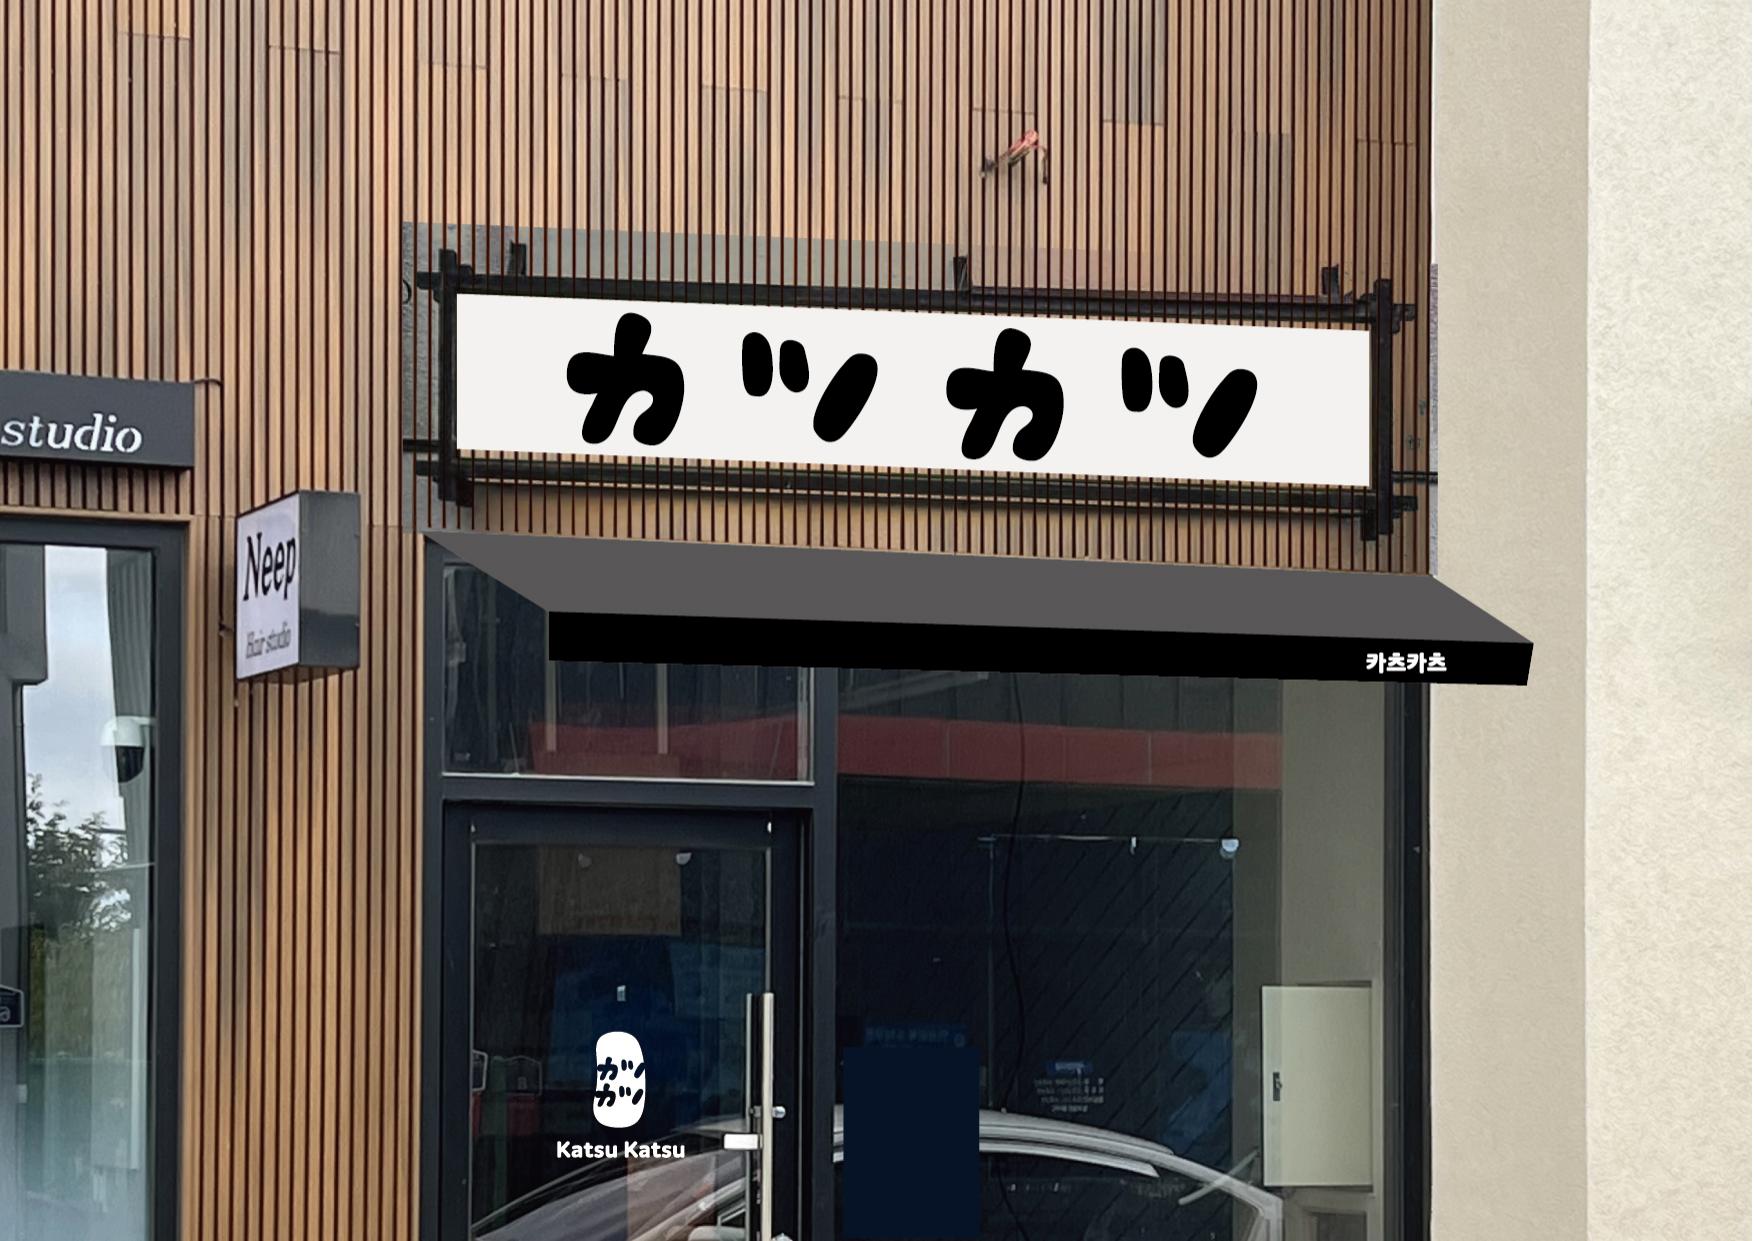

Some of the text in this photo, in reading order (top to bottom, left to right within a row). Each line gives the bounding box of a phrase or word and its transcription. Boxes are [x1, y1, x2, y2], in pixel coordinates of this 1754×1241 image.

[567, 313, 1258, 461] カツカツ
[1, 412, 142, 453] studio
[243, 532, 296, 601] Neep
[1366, 651, 1447, 674] 카츠카츠
[597, 1056, 645, 1080] カツ
[595, 1083, 644, 1107] カツ
[556, 1141, 685, 1159] Katsu Katsu
